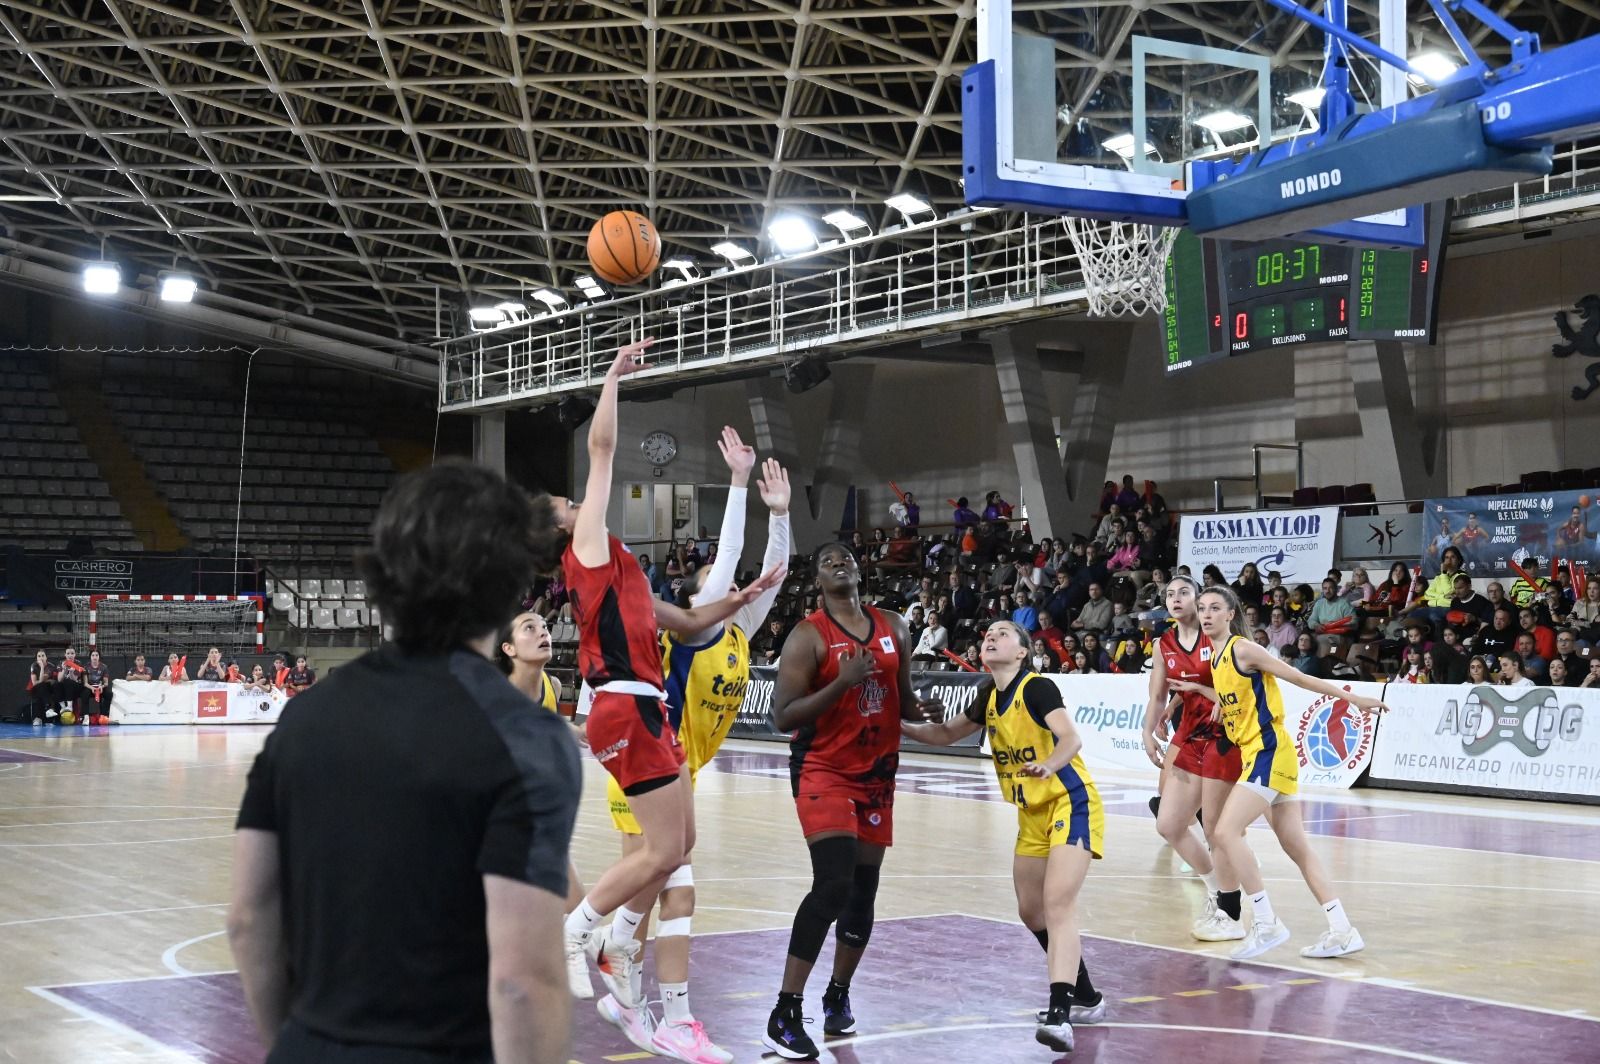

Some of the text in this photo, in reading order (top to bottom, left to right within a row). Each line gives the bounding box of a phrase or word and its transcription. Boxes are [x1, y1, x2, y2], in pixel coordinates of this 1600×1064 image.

[1281, 169, 1341, 198] MONDO
[1362, 248, 1375, 263] 13
[1257, 245, 1320, 286] 08:37
[1420, 260, 1428, 273] 3
[1319, 274, 1349, 285] MONDO
[1339, 298, 1345, 322] 1
[1236, 313, 1247, 338] 0
[1328, 327, 1349, 337] FALTAS
[1272, 333, 1307, 345] EXCLUSIONES
[1394, 329, 1426, 337] MONDO
[1232, 341, 1250, 351] FALTAS
[1167, 360, 1193, 372] MONDO
[1487, 498, 1538, 511] MIPELLEYMAS
[1511, 509, 1529, 520] LEÓN
[1192, 514, 1321, 541] GESMANCLOR
[1495, 525, 1516, 535] HAZTE
[1490, 536, 1517, 544] ABONADO
[1222, 543, 1278, 555] Mantenimiento
[1285, 541, 1319, 552] Cloración
[61, 562, 126, 573] CARRERO
[60, 578, 125, 589] & TEZZA
[711, 674, 746, 698] teik
[1111, 737, 1131, 750] Toda
[1393, 752, 1501, 774] MECANIZADO
[1302, 771, 1342, 785] LEÓN
[1010, 783, 1029, 809] 14
